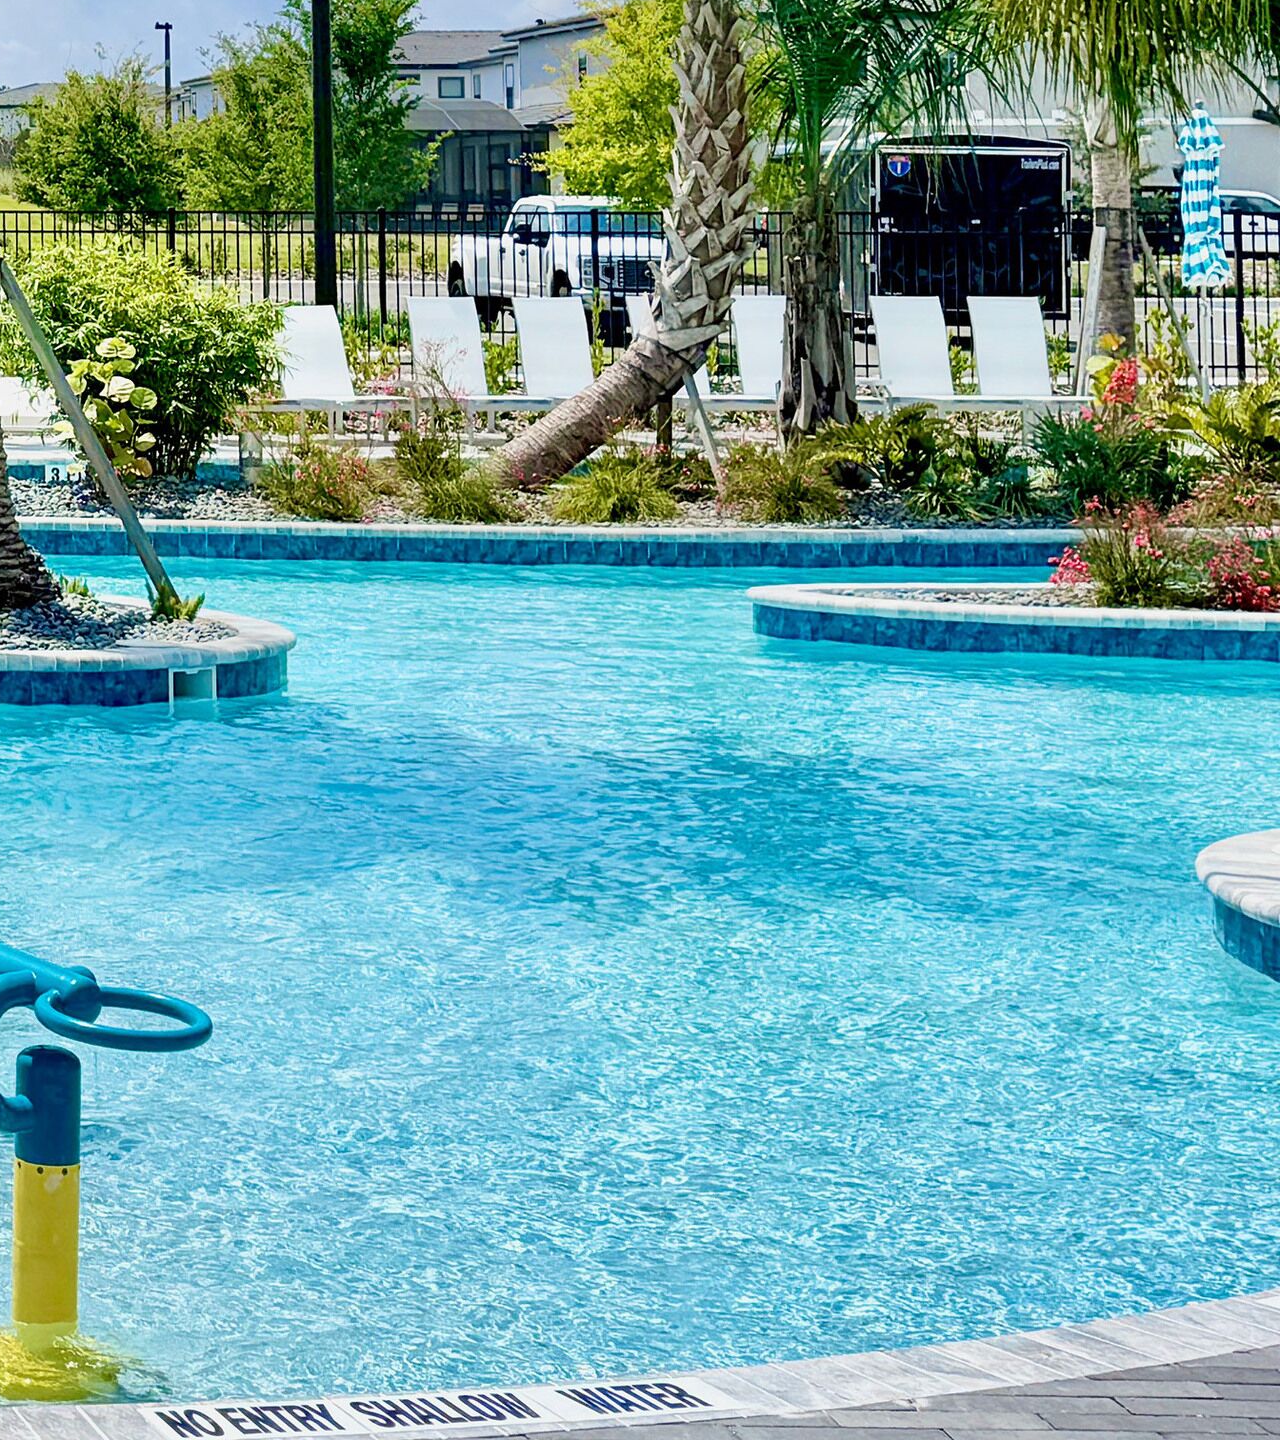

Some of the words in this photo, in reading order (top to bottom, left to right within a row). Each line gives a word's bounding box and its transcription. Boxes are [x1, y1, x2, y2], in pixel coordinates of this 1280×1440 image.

[51, 467, 60, 481] 3
[156, 1409, 226, 1438] NO
[216, 1404, 346, 1435] ENTRY
[349, 1392, 540, 1428] SHALLOW
[556, 1382, 713, 1414] WATER
